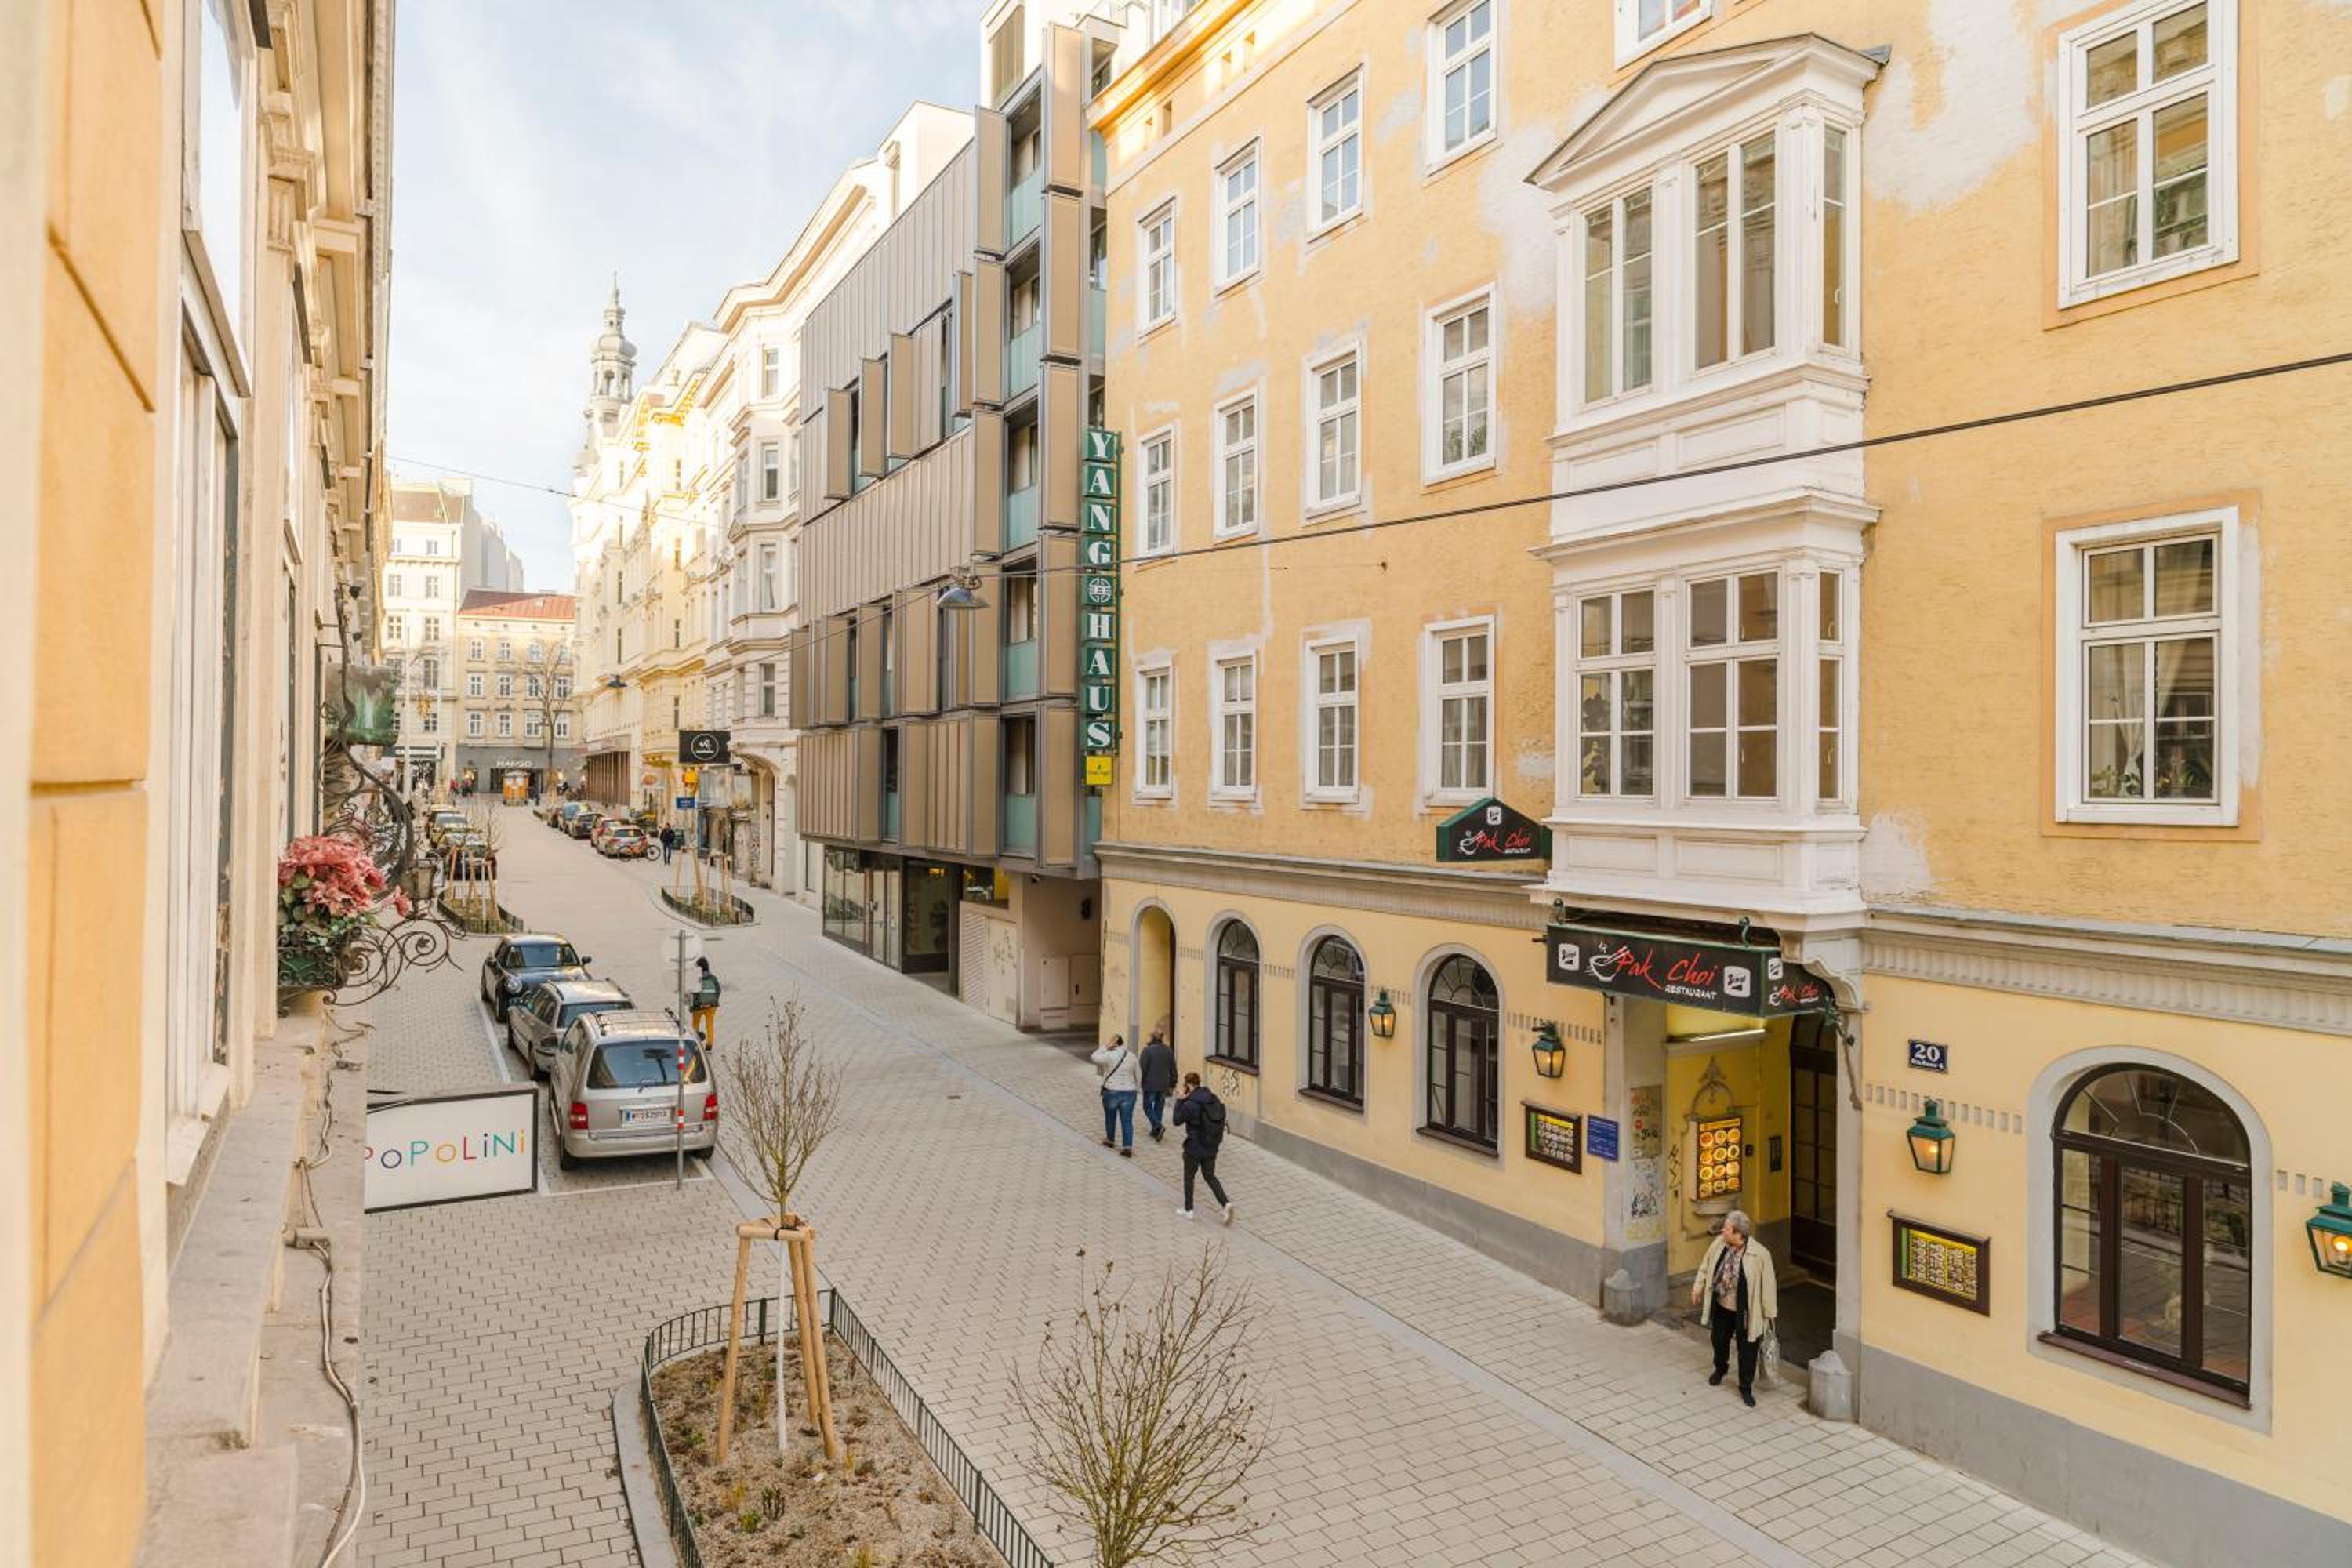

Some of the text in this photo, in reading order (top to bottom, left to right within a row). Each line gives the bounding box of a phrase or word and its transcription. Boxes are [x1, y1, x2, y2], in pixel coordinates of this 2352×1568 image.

[1087, 432, 1112, 567] YANG
[1087, 613, 1112, 748] HAUS
[1615, 948, 1664, 990] Pak
[1666, 953, 1719, 985] Choi
[1664, 983, 1718, 1000] RESTAURANT
[1914, 1044, 1940, 1062] 20
